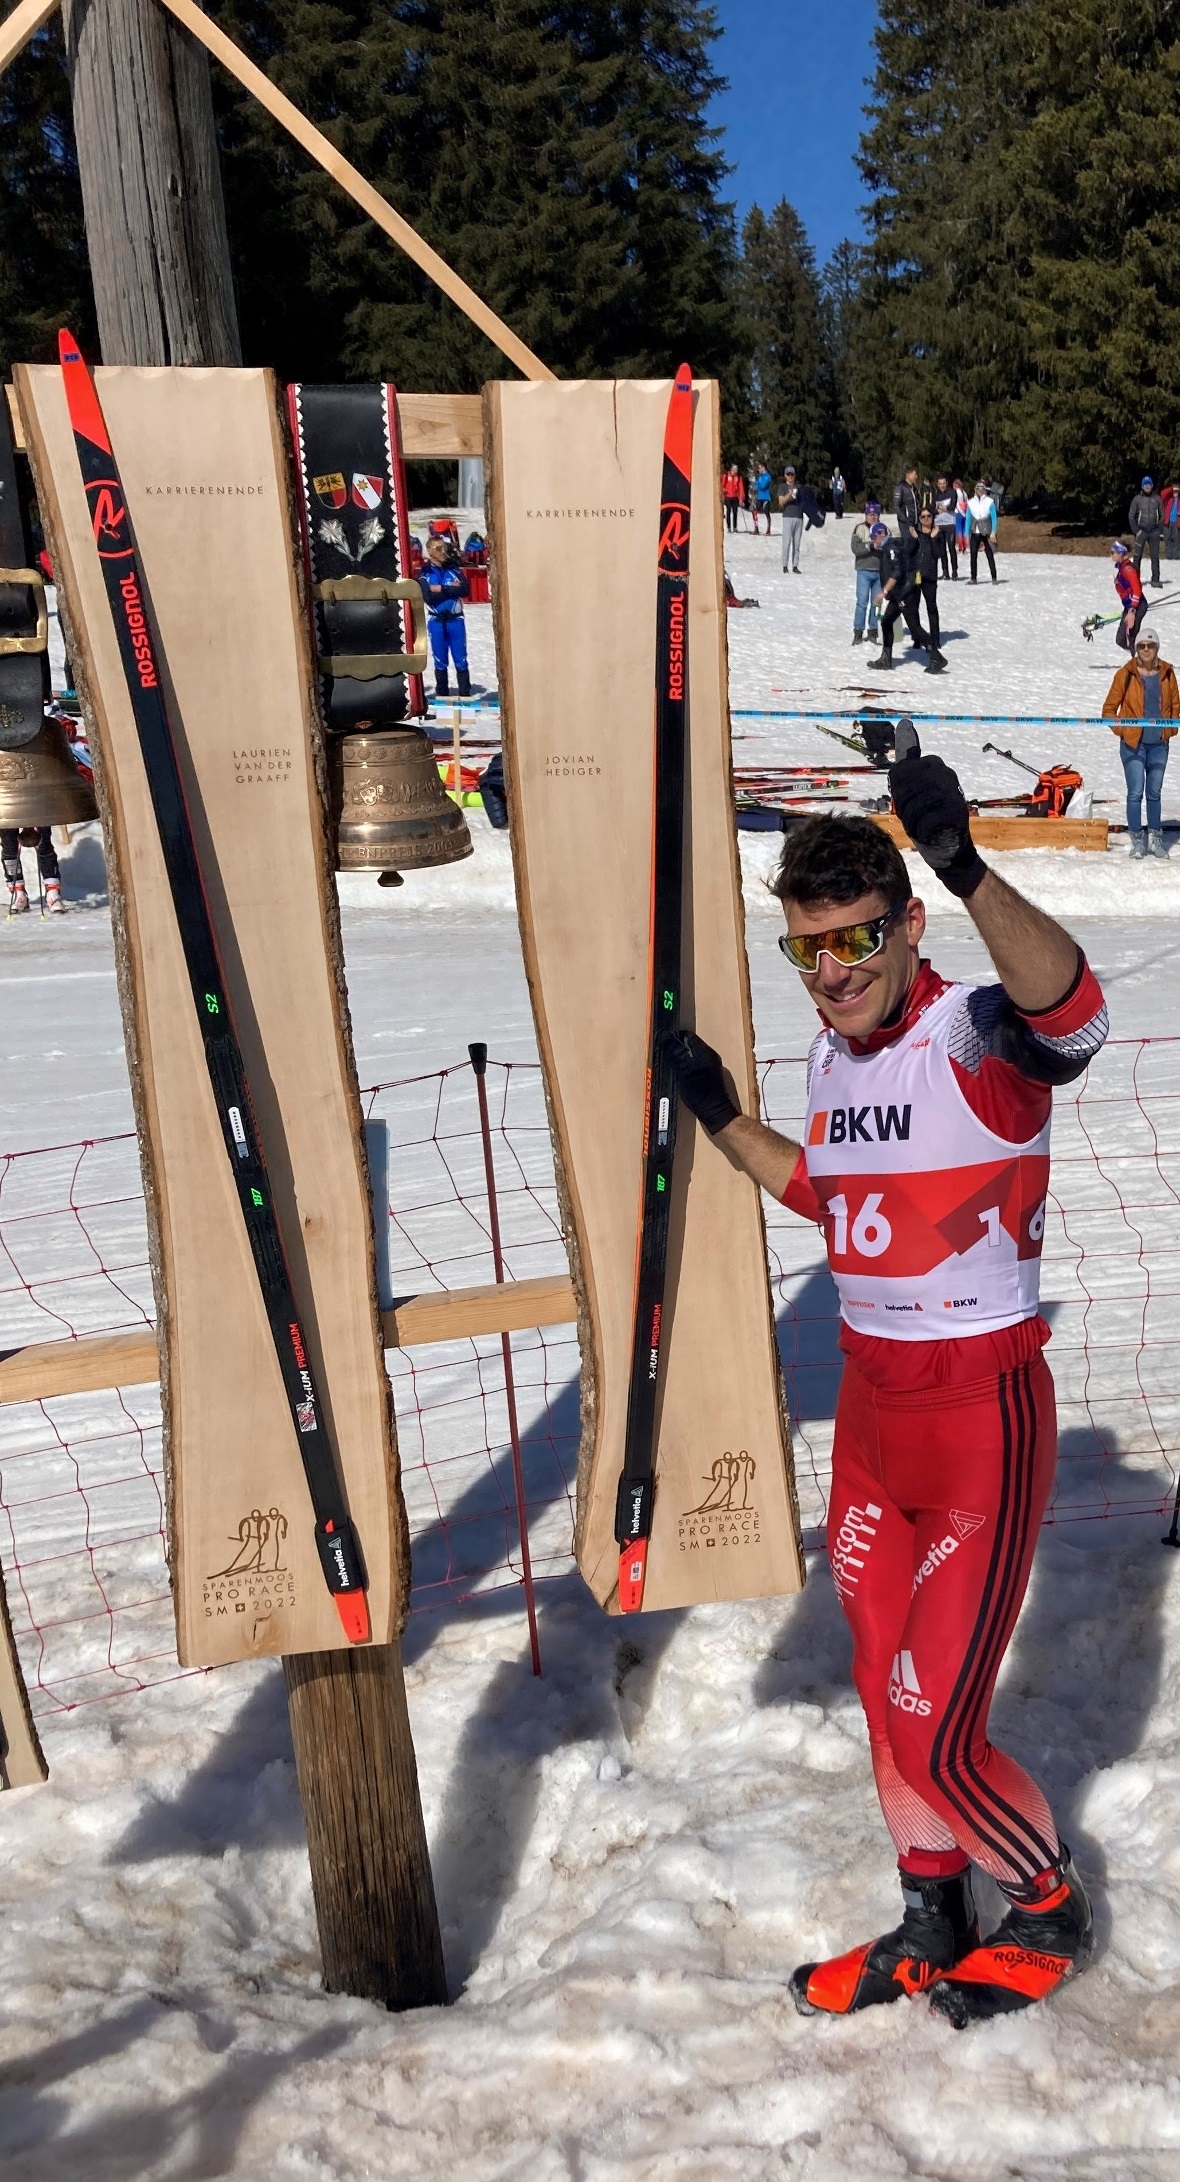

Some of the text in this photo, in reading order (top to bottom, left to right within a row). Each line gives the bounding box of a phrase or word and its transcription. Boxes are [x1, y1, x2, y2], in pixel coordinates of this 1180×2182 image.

[146, 486, 263, 495] KARRIERENENDE
[526, 509, 635, 518] KARRIERENENDE
[120, 571, 158, 688] ROSSIGNOL
[669, 590, 685, 700] ROSSIGNOL
[233, 749, 291, 758] LAURIEN
[546, 755, 594, 764] JOVIAN
[234, 761, 291, 770] VAN DER
[546, 768, 601, 776] HEDIGER
[236, 774, 289, 783] GRAAFF
[206, 993, 218, 1013] S2
[664, 990, 673, 1010] S2
[829, 1104, 912, 1144] BKW
[657, 1173, 665, 1191] 187
[251, 1187, 263, 1206] 187
[827, 1193, 892, 1258] 16
[978, 1200, 1046, 1247] 1 6
[885, 1304, 913, 1312] helvetia
[953, 1298, 977, 1308] BKW
[651, 1304, 662, 1347] PREMIUM
[289, 1322, 307, 1369] PREMIUM
[630, 1497, 642, 1534] helvetia
[679, 1511, 760, 1527] SPARENMOOS
[679, 1520, 760, 1537] PRO RACE
[679, 1533, 761, 1551] SM 2022
[333, 1549, 350, 1587] helvetia
[203, 1573, 294, 1591] SPARENMOOS
[203, 1582, 296, 1602] PRO RACE
[205, 1596, 296, 1617] SM 2022
